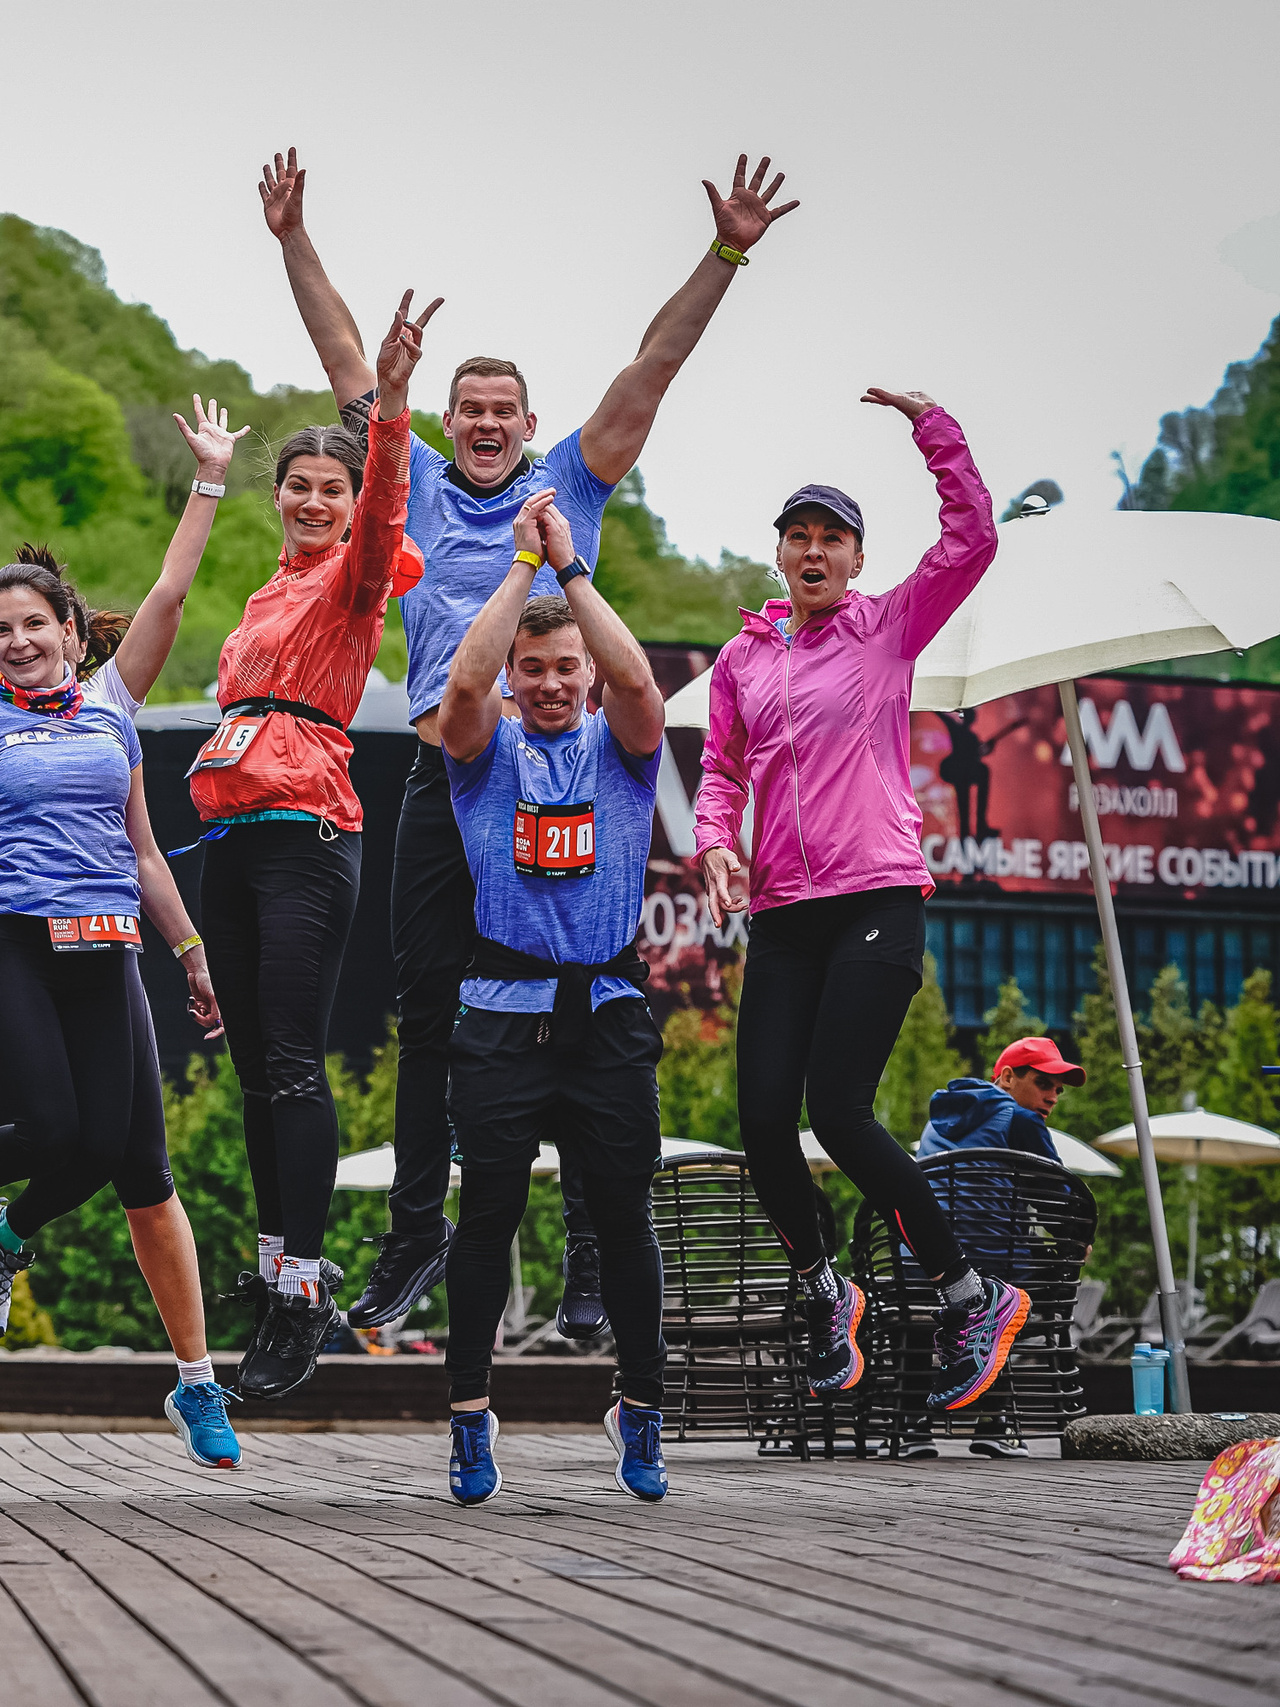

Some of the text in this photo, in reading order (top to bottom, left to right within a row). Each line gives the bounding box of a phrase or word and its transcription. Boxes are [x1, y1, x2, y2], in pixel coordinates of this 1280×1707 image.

[236, 729, 250, 747] 5
[546, 825, 588, 858] 21 1
[921, 833, 1044, 879] САМЫЕ
